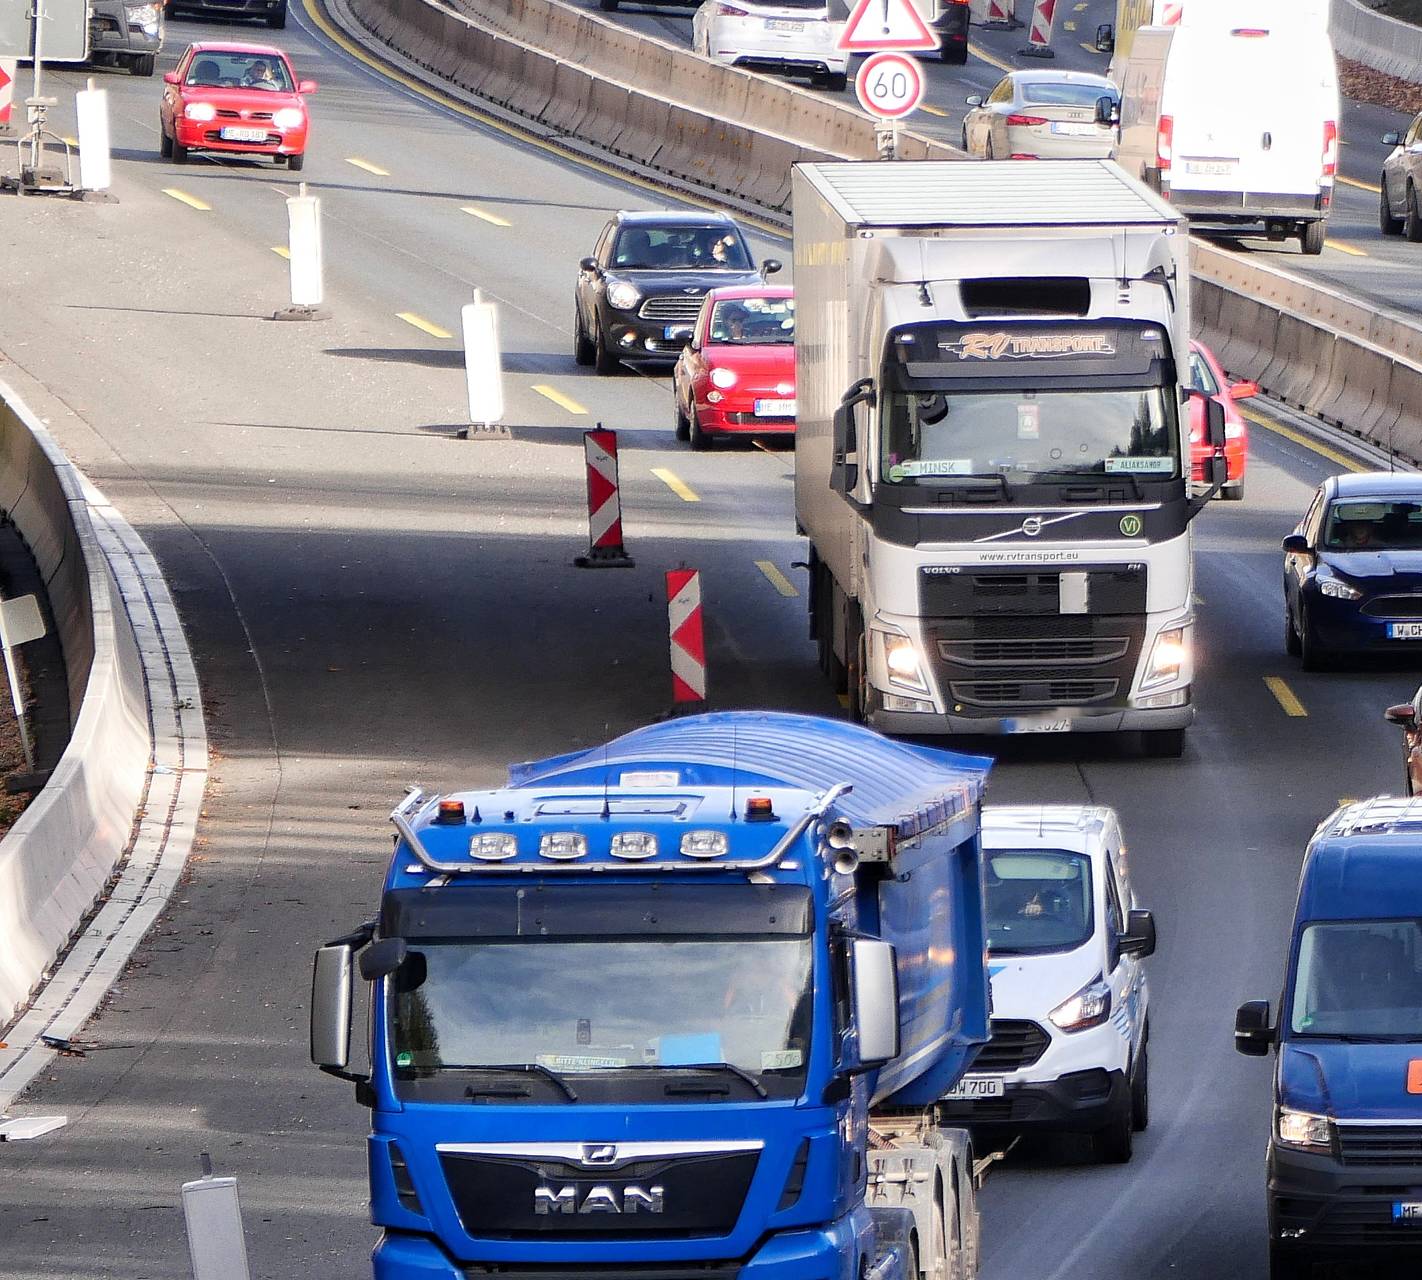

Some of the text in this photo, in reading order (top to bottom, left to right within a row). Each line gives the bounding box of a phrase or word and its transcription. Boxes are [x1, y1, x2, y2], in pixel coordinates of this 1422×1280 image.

[873, 72, 907, 98] 60
[1011, 335, 1105, 353] TRANSPORT
[920, 462, 956, 474] MINSK
[979, 552, 1079, 563] www.rvtransport.eu
[1396, 625, 1405, 636] W
[970, 1081, 996, 1094] 700
[534, 1186, 665, 1214] MAN
